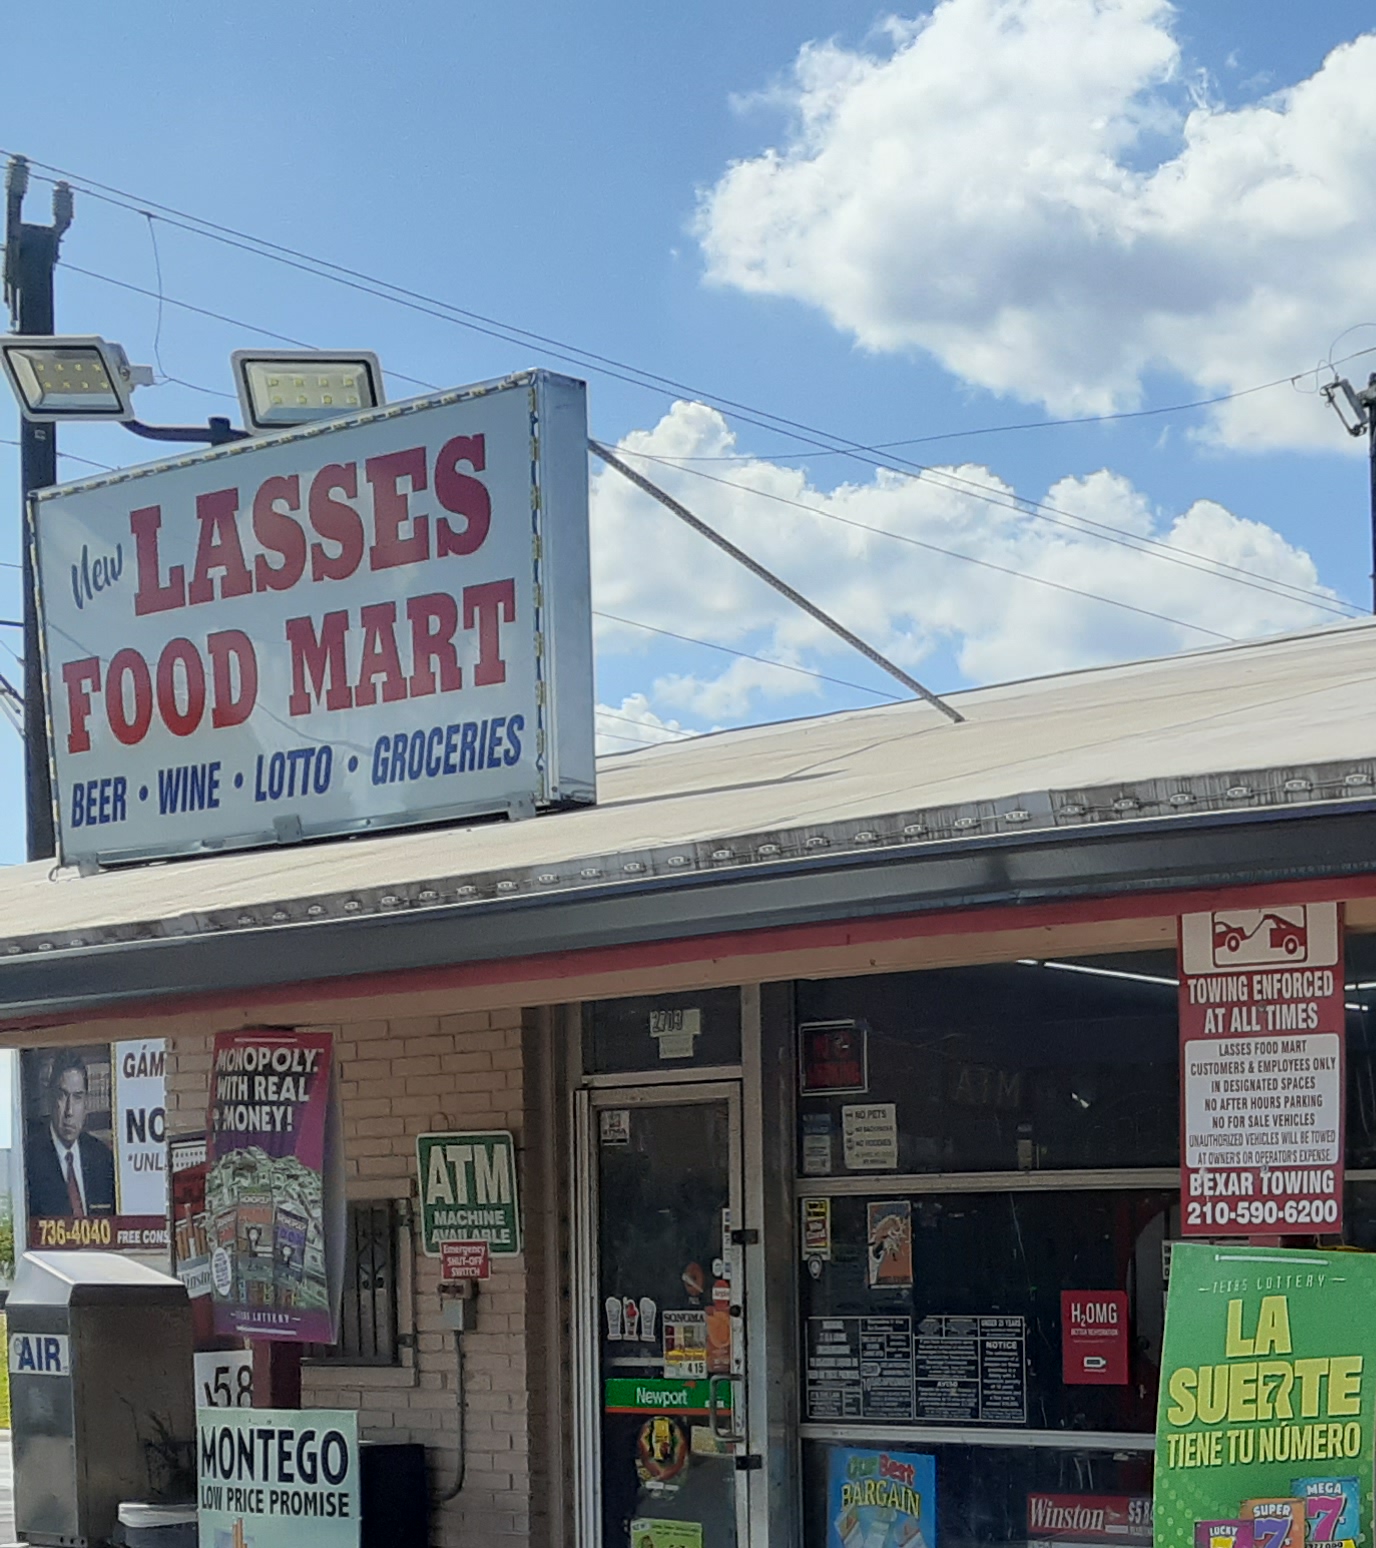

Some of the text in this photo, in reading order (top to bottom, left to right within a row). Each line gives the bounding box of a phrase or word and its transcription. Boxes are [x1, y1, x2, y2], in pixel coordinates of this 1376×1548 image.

[71, 433, 492, 617] New LASSES
[62, 579, 516, 754] FOOD MART
[71, 713, 525, 829] BEER WINE LOTTO GROCERIES
[1188, 970, 1333, 1004] TOWING ENFORCED
[1204, 1002, 1318, 1034] AT ALL TIMES
[1219, 1040, 1307, 1057] LASSES FOOD MART
[1190, 1057, 1336, 1076] CUSTOMERS & EMPLOYEES ONLY
[217, 1075, 310, 1102] WITH REAL
[1211, 1076, 1316, 1093] IN DESIGNATED SPACES
[868, 1109, 887, 1119] PETS
[1204, 1094, 1323, 1112] NO AFTER HOURS PARKING
[223, 1105, 293, 1132] MONEY!
[1212, 1113, 1316, 1129] NO FOR SALE VEHICLES
[1189, 1130, 1336, 1148] UNAUTHORIZED VEHICLES WILL BE TOWED
[1197, 1152, 1207, 1165] AT
[1243, 1150, 1253, 1164] OR
[426, 1144, 511, 1205] ATM
[1190, 1169, 1334, 1196] BEXAR TOWING
[434, 1210, 506, 1226] MACHINE
[1187, 1200, 1338, 1225] 210-590-6200
[39, 1219, 111, 1246] 736-4040
[117, 1230, 141, 1244] FREE
[431, 1228, 511, 1243] AVAILABLE
[444, 1245, 485, 1256] Emergency
[447, 1256, 484, 1266] SHUT-OFF
[451, 1267, 480, 1277] SWITCH
[1256, 1274, 1326, 1291] LOTTERY
[1226, 1295, 1293, 1357] LA
[18, 1337, 61, 1372] AIR
[986, 1341, 1018, 1350] NOTICE
[636, 1387, 688, 1407] Newport
[1167, 1355, 1364, 1427] SUERTE
[201, 1426, 349, 1486] MONTEGO
[1167, 1422, 1360, 1469] TIENE TU NÚMERO
[880, 1454, 914, 1486] Best
[842, 1479, 921, 1519] BARGAIN
[1307, 1483, 1342, 1496] MEGA
[201, 1487, 350, 1518] LOW PRICE PROMISE
[1253, 1504, 1291, 1517] SUPER
[1030, 1497, 1105, 1531] Winston
[1209, 1525, 1238, 1537] LUCKY
